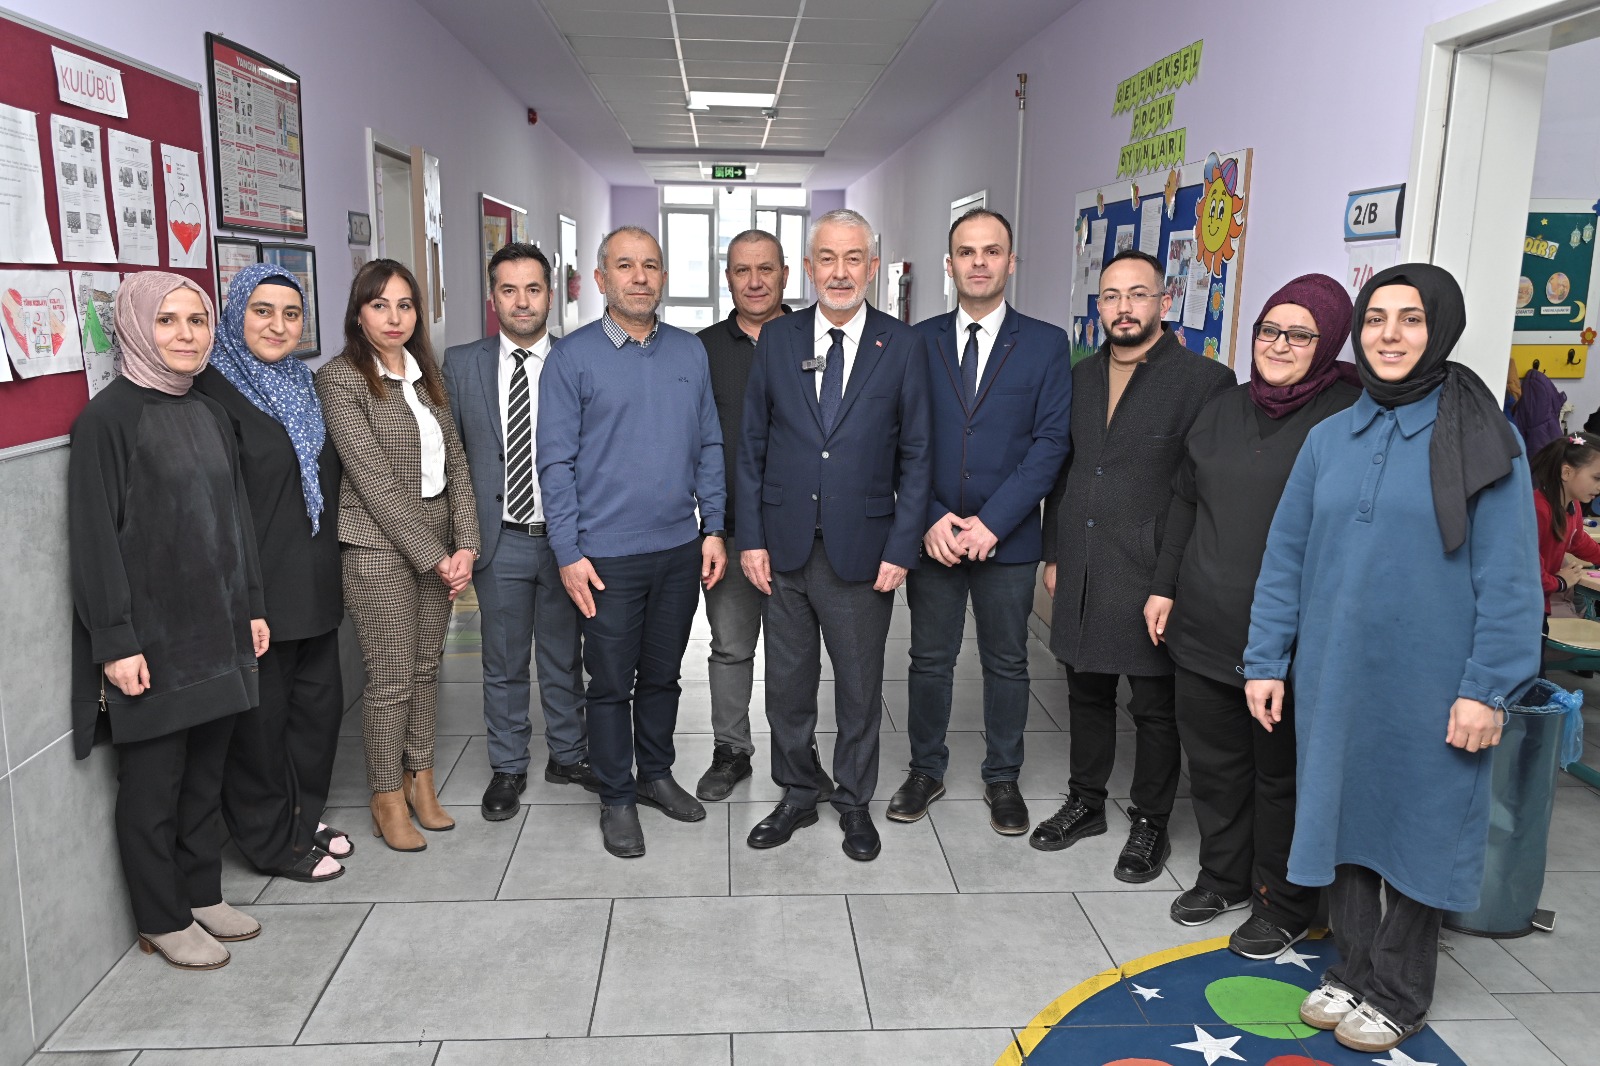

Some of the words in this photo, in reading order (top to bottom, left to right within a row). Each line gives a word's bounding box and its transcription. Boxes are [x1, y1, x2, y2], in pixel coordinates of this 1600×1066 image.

[60, 65, 116, 103] KULÜBÜ
[1116, 49, 1199, 104] GELENEKSEL
[1121, 134, 1183, 167] OYUNLARI
[1353, 202, 1378, 226] 2/B
[1352, 263, 1374, 291] 7/A
